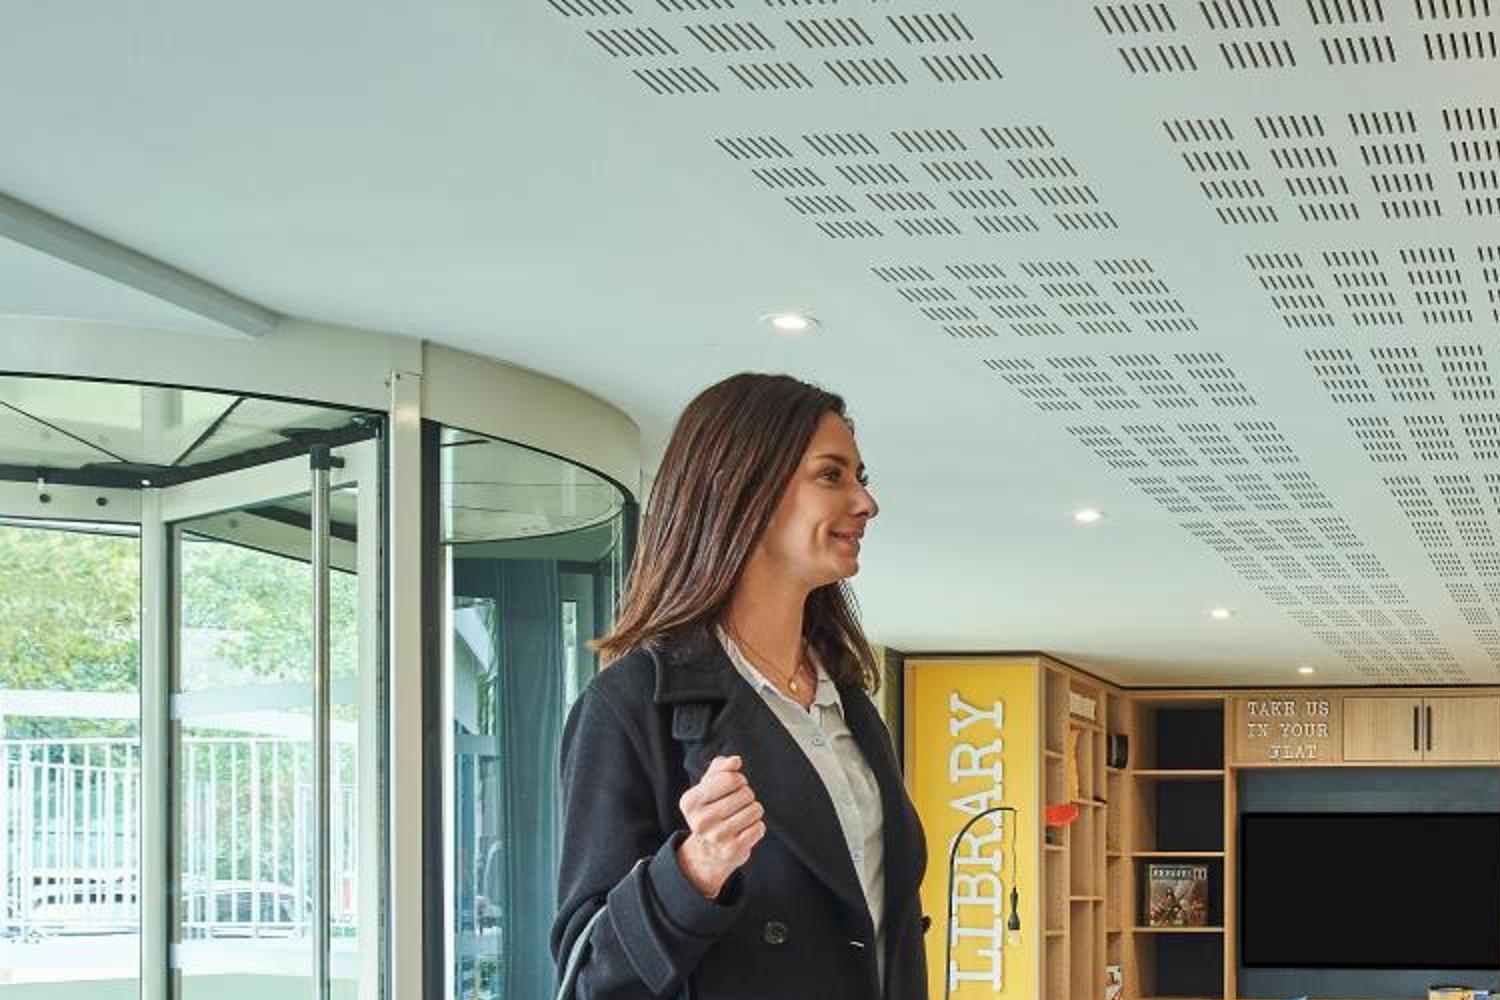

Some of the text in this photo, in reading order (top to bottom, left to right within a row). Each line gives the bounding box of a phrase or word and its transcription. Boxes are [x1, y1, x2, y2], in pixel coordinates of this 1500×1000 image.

[1247, 701, 1329, 716] TAKE US
[1247, 723, 1328, 737] IN YOUR
[950, 692, 1003, 993] LIBRARY
